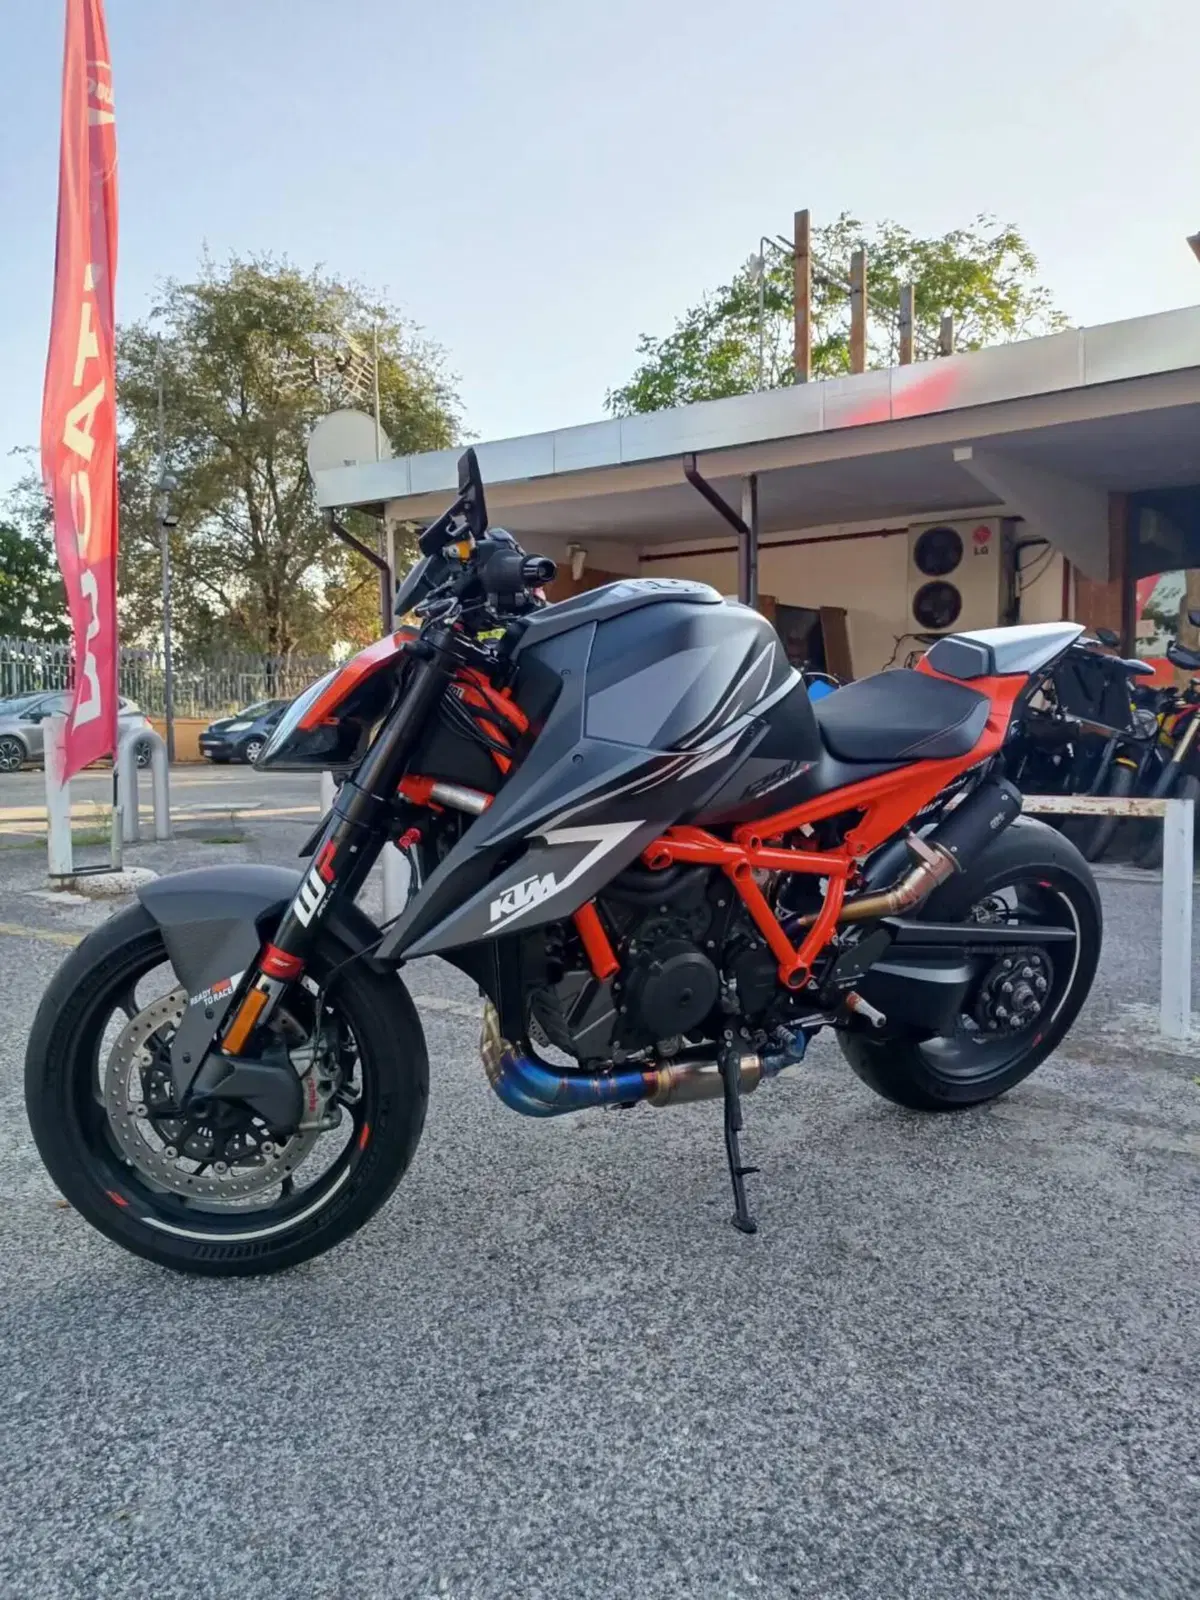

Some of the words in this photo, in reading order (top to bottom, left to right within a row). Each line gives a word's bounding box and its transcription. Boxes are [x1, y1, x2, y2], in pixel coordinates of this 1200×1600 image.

[974, 546, 988, 555] LG
[490, 872, 560, 922] KTM
[190, 988, 211, 1006] READY
[203, 996, 214, 1006] TO
[213, 986, 233, 1002] RACE
